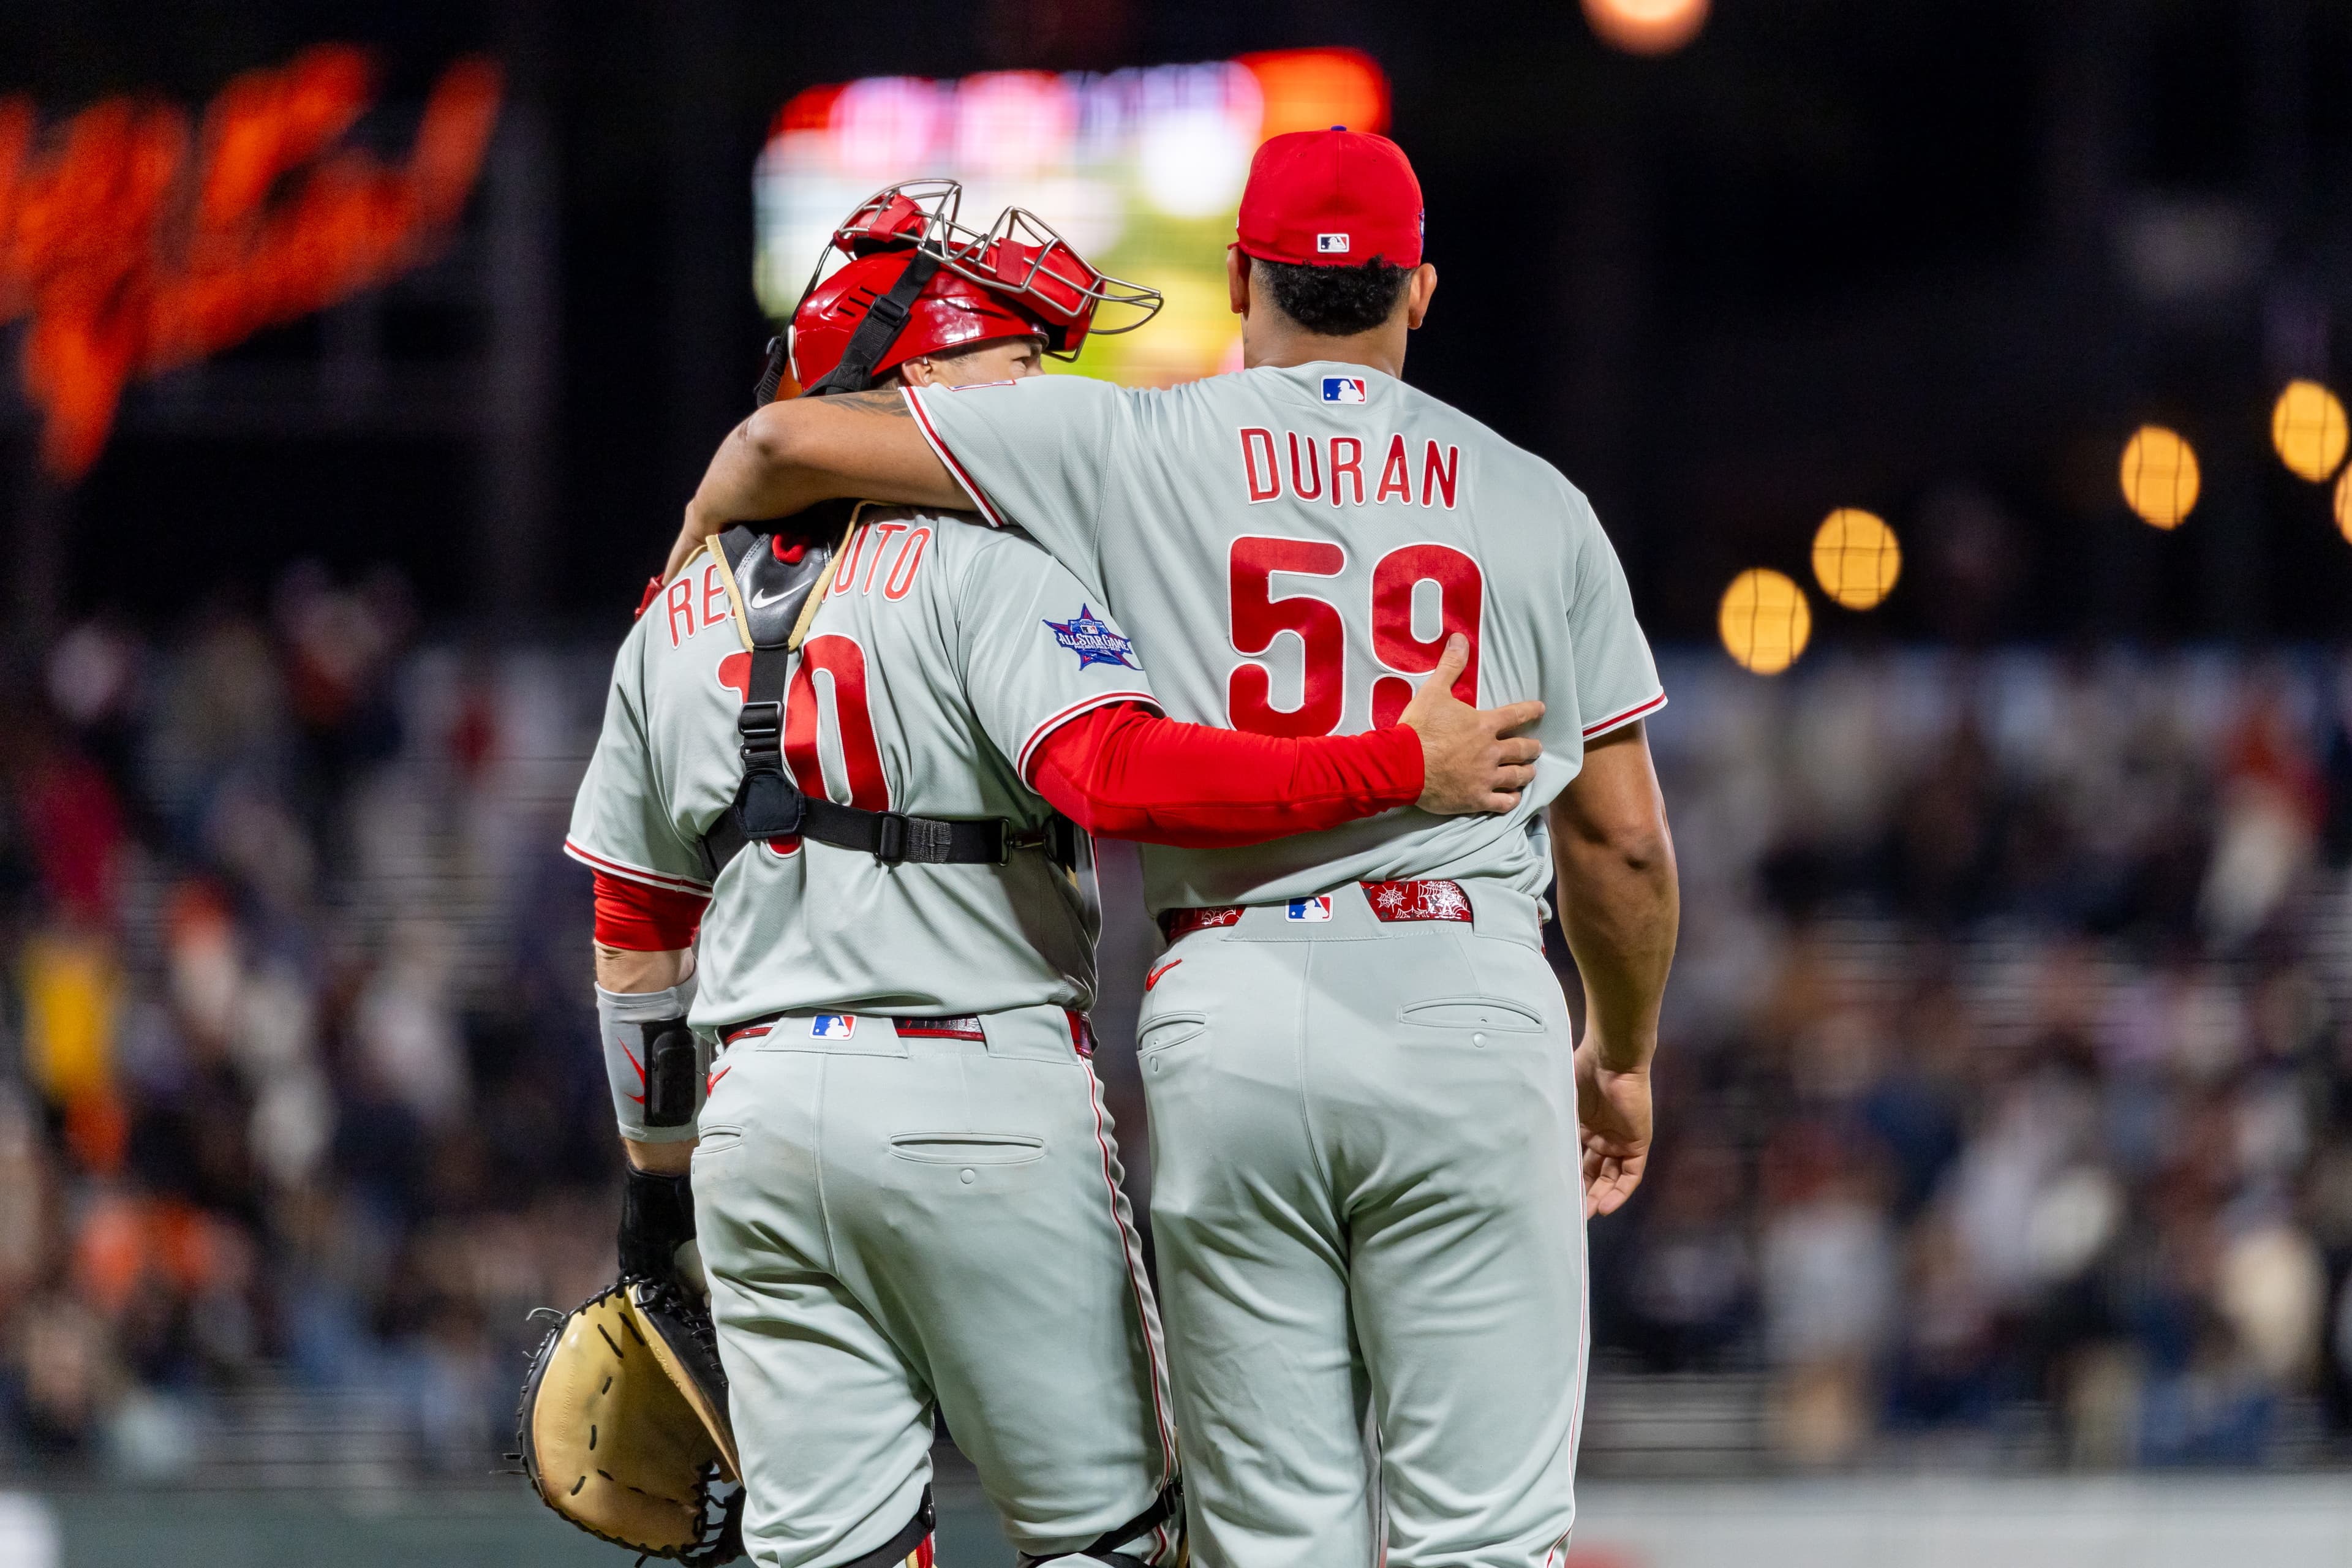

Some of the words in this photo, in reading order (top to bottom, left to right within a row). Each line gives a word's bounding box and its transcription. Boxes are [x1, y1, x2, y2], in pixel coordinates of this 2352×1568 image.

[1238, 427, 1460, 511] DURAN
[667, 521, 932, 650] REUTO
[1226, 533, 1485, 736] 59
[1101, 634, 1129, 650] GAME
